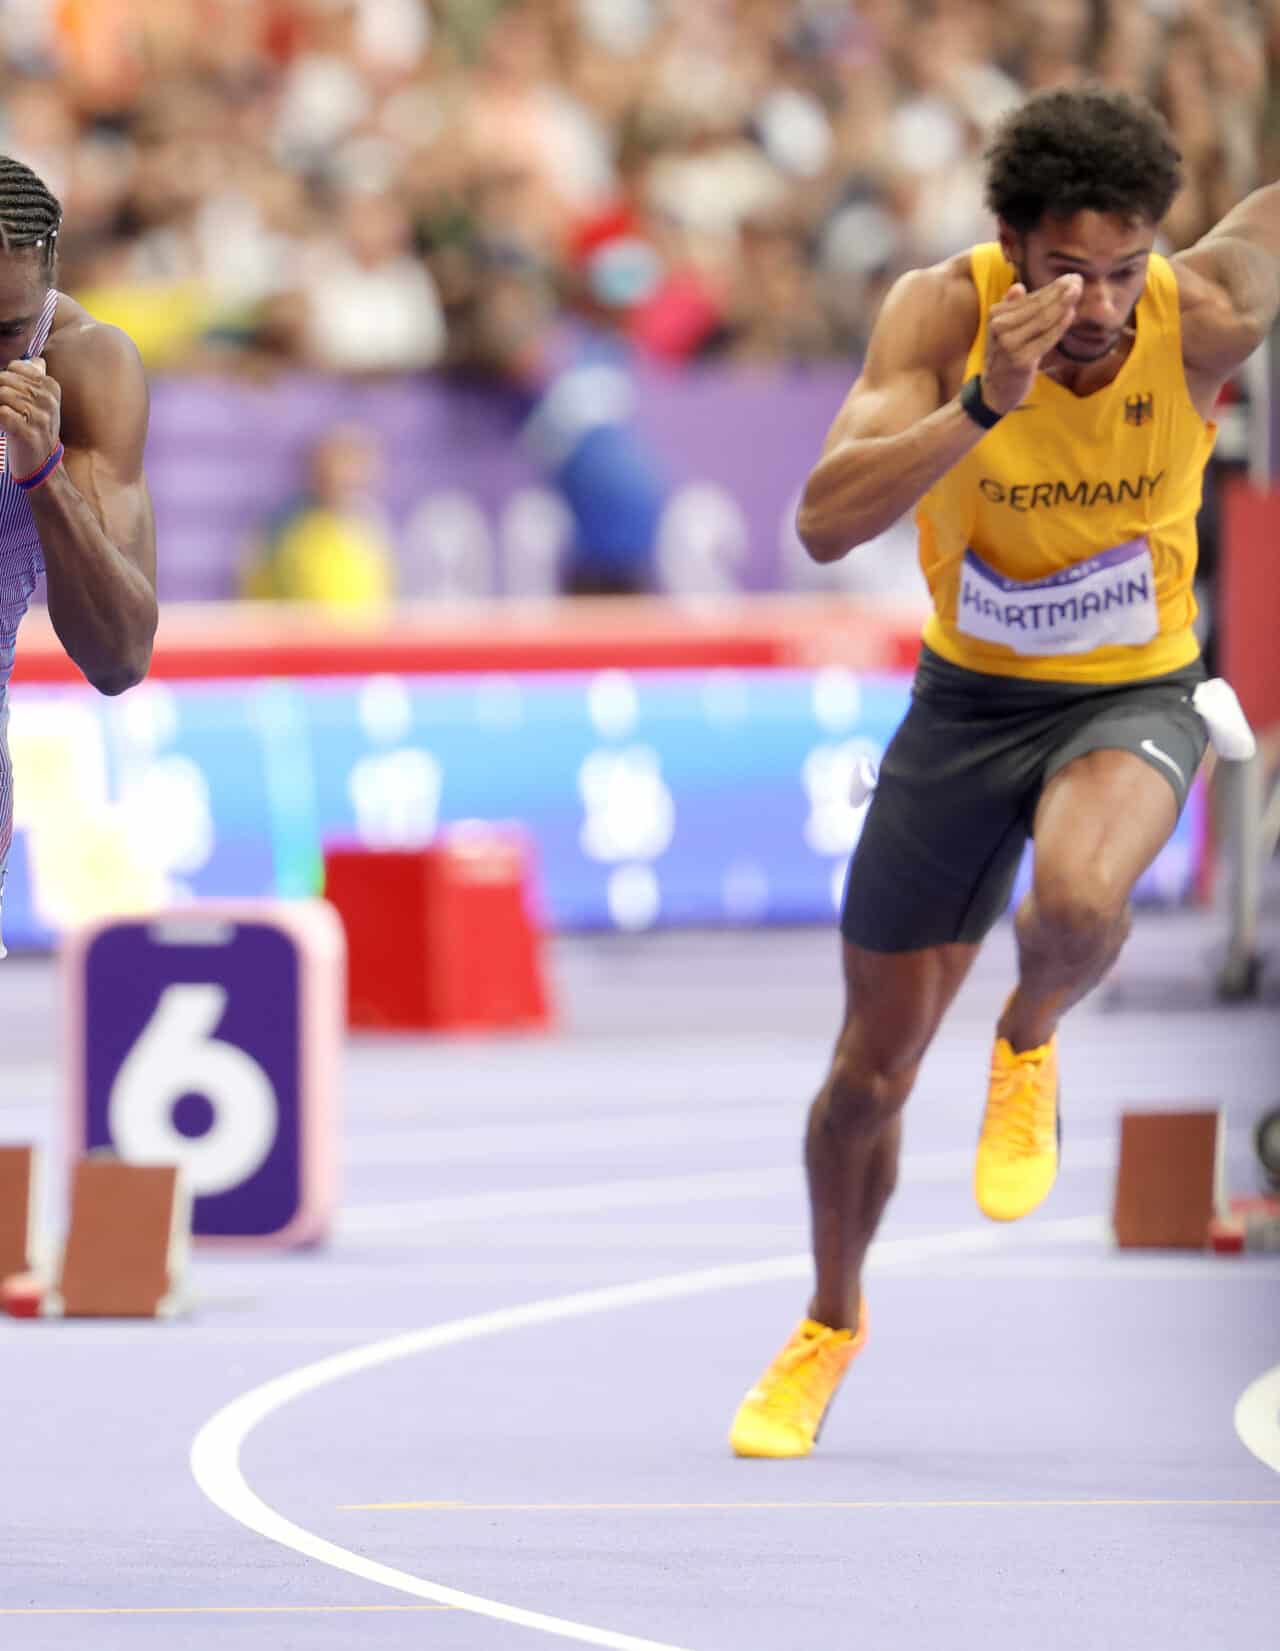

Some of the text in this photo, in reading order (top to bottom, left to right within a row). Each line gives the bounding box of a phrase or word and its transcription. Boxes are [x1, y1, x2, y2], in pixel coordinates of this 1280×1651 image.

[979, 469, 1166, 512] GERMANY
[962, 572, 1150, 630] HARTMANN
[108, 982, 278, 1198] 6
